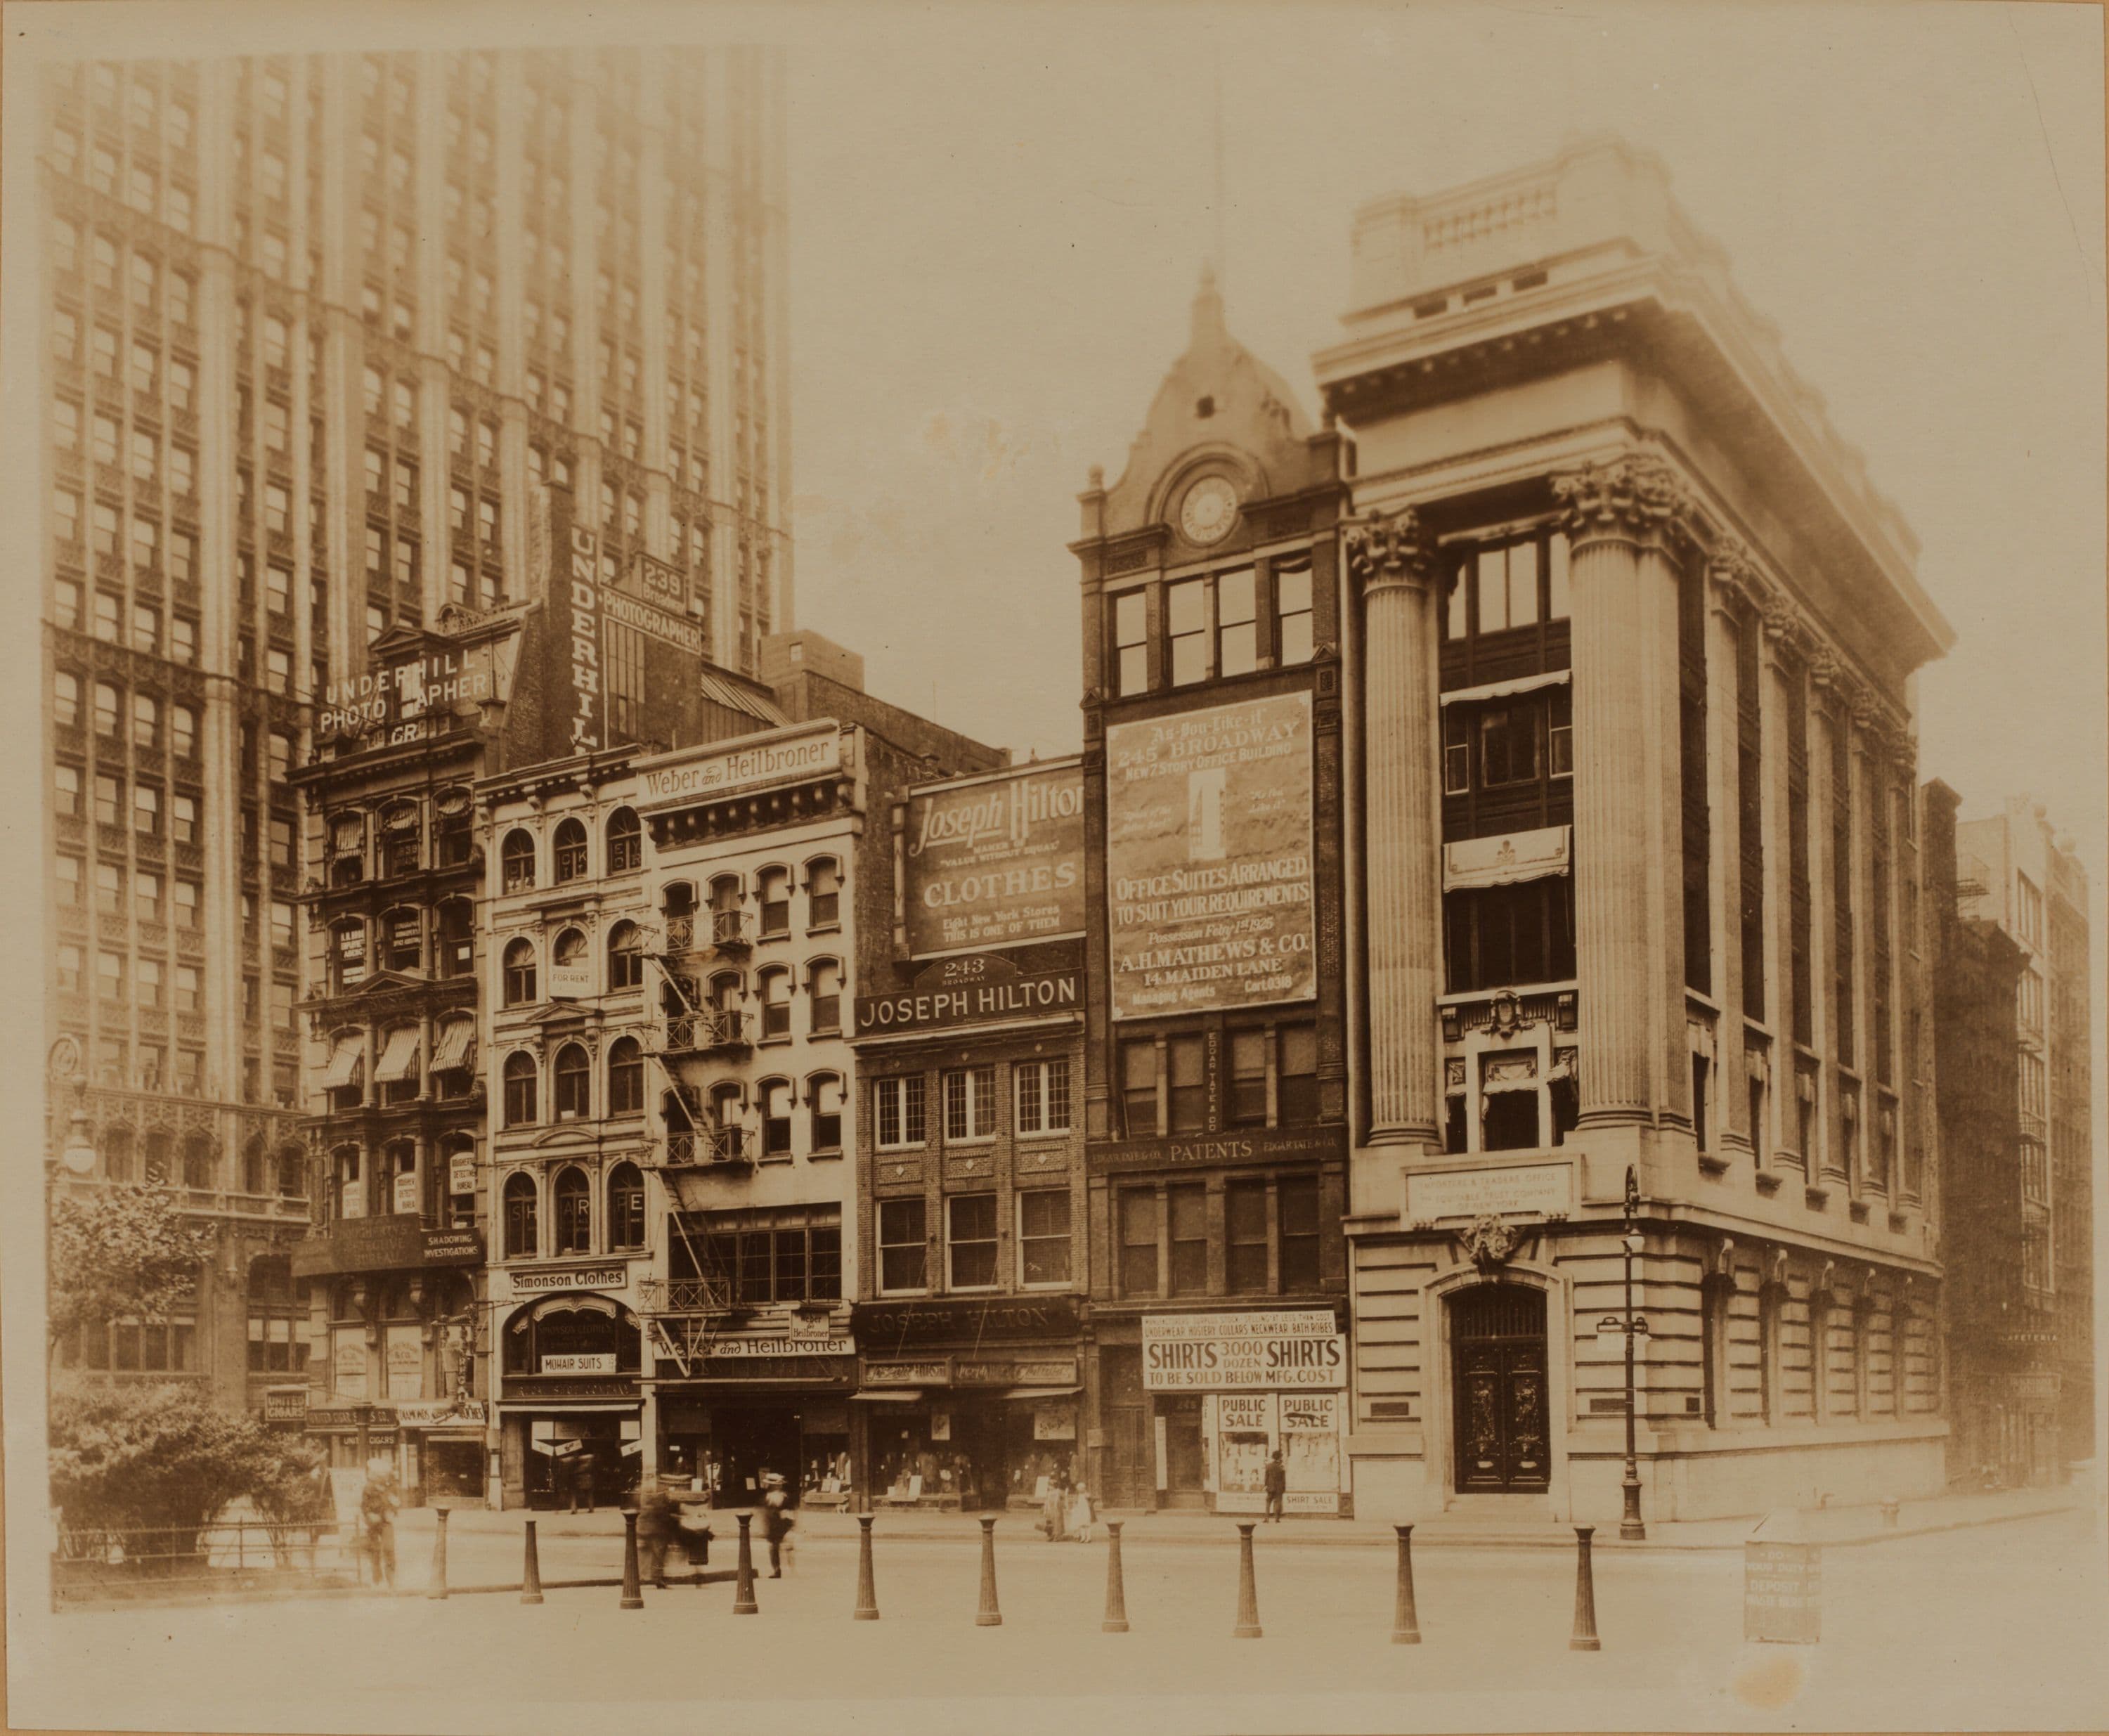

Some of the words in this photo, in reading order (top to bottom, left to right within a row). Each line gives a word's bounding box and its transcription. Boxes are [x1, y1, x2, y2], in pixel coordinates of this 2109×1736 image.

[644, 562, 680, 595] 239
[603, 590, 700, 650] PHOTOGRAPHER
[320, 699, 387, 734] PHOTO
[1117, 746, 1158, 768] 245
[1170, 721, 1299, 759] BROADWAY
[647, 770, 700, 798] Weber
[725, 741, 829, 782] Heilbroner
[1126, 765, 1148, 782] NEW
[1159, 758, 1194, 775] STORY
[1196, 751, 1237, 769] OFFICE
[1239, 741, 1292, 763] BUILDING
[908, 792, 1004, 857] Joseph
[923, 862, 1076, 908] CLOTHES
[1116, 875, 1172, 901] OFFICE
[1172, 867, 1228, 893] SUITES
[1229, 856, 1307, 886] ARRANGED
[1116, 906, 1134, 926] TO
[1136, 900, 1169, 923] SUIT
[1170, 895, 1207, 918] YOUR
[1209, 881, 1310, 913] REQUIREMENTS
[942, 918, 968, 931] Eight
[972, 914, 991, 926] New
[994, 909, 1019, 922] York
[1023, 905, 1060, 918] Stores
[942, 931, 966, 943] THIS
[969, 927, 980, 940] IS
[983, 924, 1004, 936] ONE
[1008, 921, 1023, 933] OF
[1027, 916, 1060, 931] THEM
[1259, 937, 1275, 955] &
[1278, 933, 1310, 953] CO.
[552, 973, 569, 983] FOR
[945, 959, 984, 978] 243
[1144, 973, 1162, 987] 14
[1165, 963, 1233, 985] MAIDEN
[1236, 957, 1284, 976] LANE
[860, 990, 968, 1028] JOSEPH
[978, 977, 1076, 1013] HILTON
[1131, 990, 1178, 1005] Managing
[1181, 985, 1216, 1002] Agents
[1170, 1140, 1253, 1162] PATENTS
[428, 1234, 472, 1246] SHADOWING
[424, 1245, 478, 1259] INVESTIGATIONS
[512, 1272, 572, 1290] Simonson
[575, 1270, 623, 1286] Clothes
[867, 1311, 954, 1333] JOSEPH
[966, 1307, 1049, 1329] HILTON
[1219, 1323, 1248, 1336] COLLARS
[1250, 1323, 1288, 1335] NECKWEAR
[1292, 1322, 1310, 1334] BATH
[1311, 1321, 1333, 1333] ROBES
[793, 1328, 829, 1339] Heilbroner
[658, 1341, 717, 1356] Weer
[720, 1340, 741, 1355] and
[746, 1337, 847, 1354] Heilbroner
[1148, 1342, 1218, 1369] SHIRTS
[1220, 1341, 1264, 1356] 3000
[1266, 1339, 1341, 1368] SHIRTS
[545, 1358, 576, 1371] MOHAIR
[578, 1357, 602, 1369] SUITS
[1223, 1358, 1261, 1368] DOZEN
[1149, 1372, 1163, 1385] TO
[1167, 1372, 1182, 1385] BE
[1186, 1371, 1221, 1385] SOLD
[1225, 1371, 1263, 1384] BELOW
[268, 1392, 305, 1406] UNITED
[1222, 1399, 1266, 1412] PUBLIC
[1283, 1399, 1333, 1412] PUBLIC
[268, 1406, 305, 1418] CIGARS
[1225, 1413, 1264, 1427] SALE
[1287, 1414, 1330, 1428] SALE
[343, 1436, 359, 1445] UNIT
[369, 1436, 394, 1445] CIGARS
[1287, 1496, 1310, 1505] SHIRT
[1313, 1496, 1333, 1505] SALE
